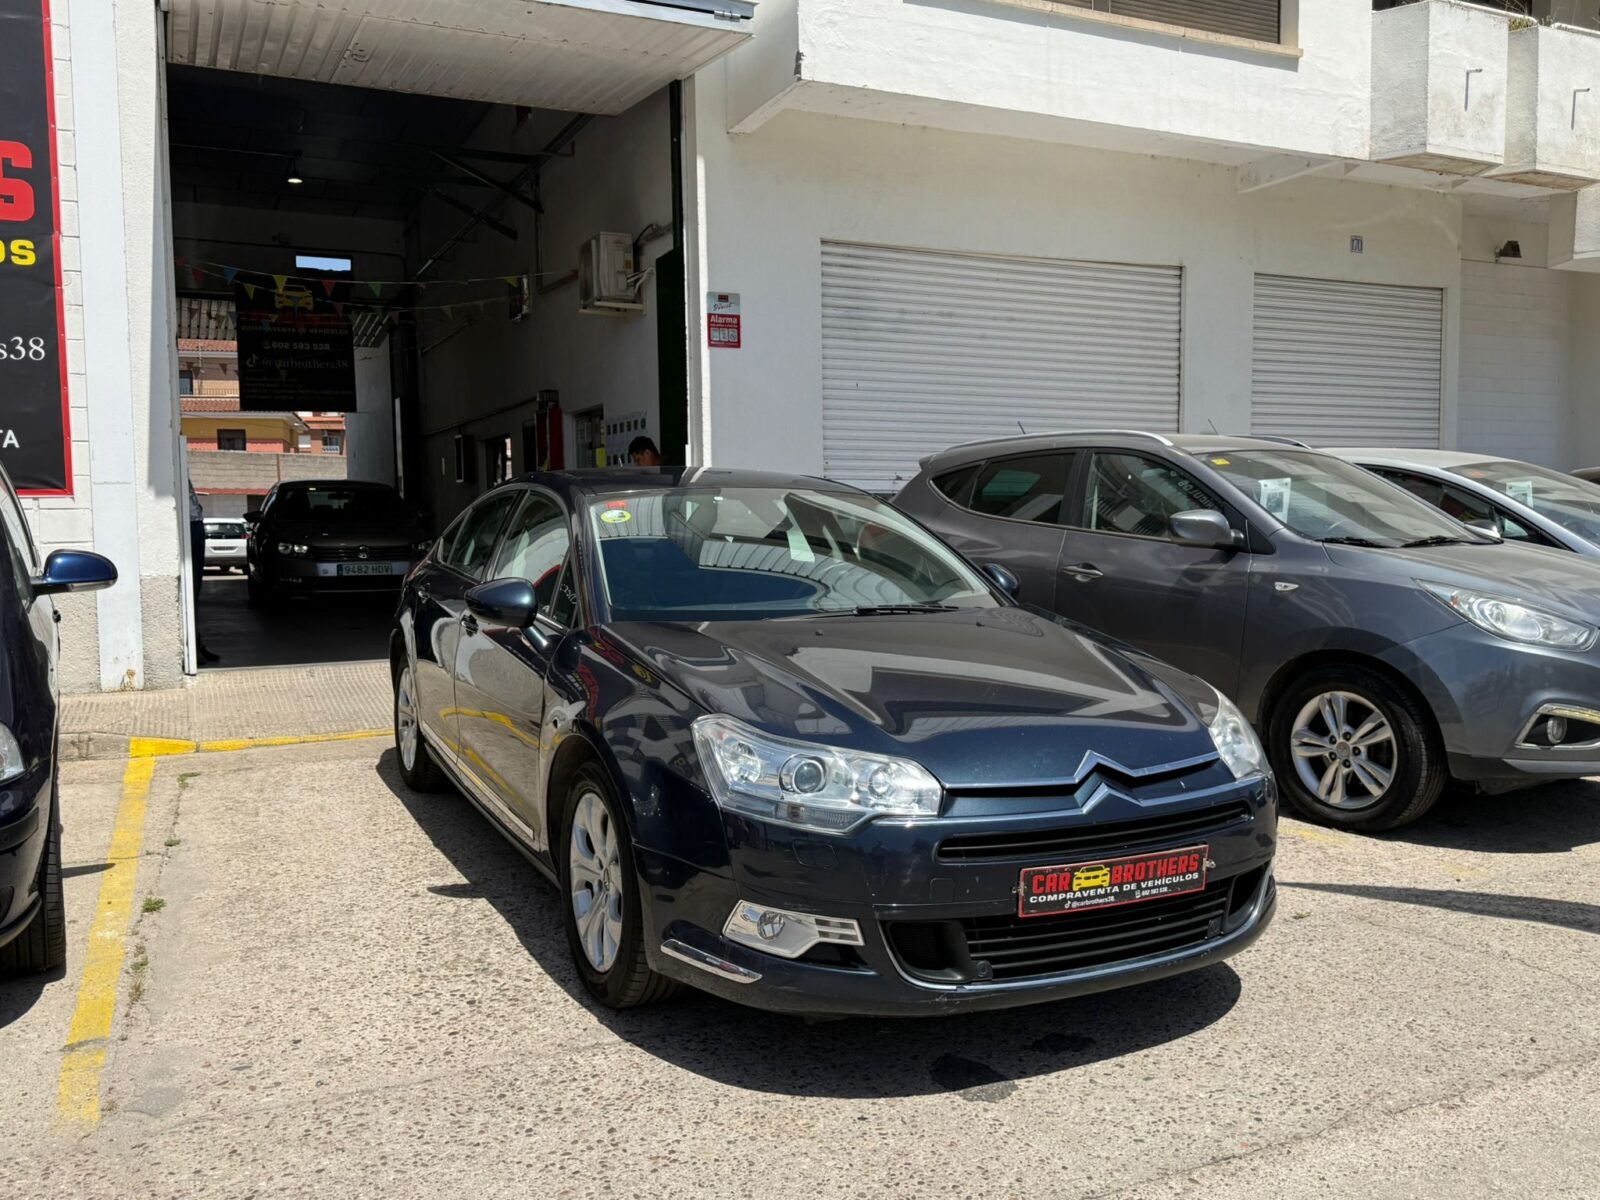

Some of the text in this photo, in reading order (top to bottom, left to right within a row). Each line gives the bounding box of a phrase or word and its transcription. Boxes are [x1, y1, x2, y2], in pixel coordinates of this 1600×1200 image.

[0, 140, 35, 221] S
[710, 315, 738, 324] Alarma
[0, 429, 20, 448] A
[345, 565, 390, 574] 9482 HDV
[1032, 853, 1200, 894] CAR BROTHERS
[1029, 872, 1199, 904] COMPRAVENTA DE VEHÍCULOS
